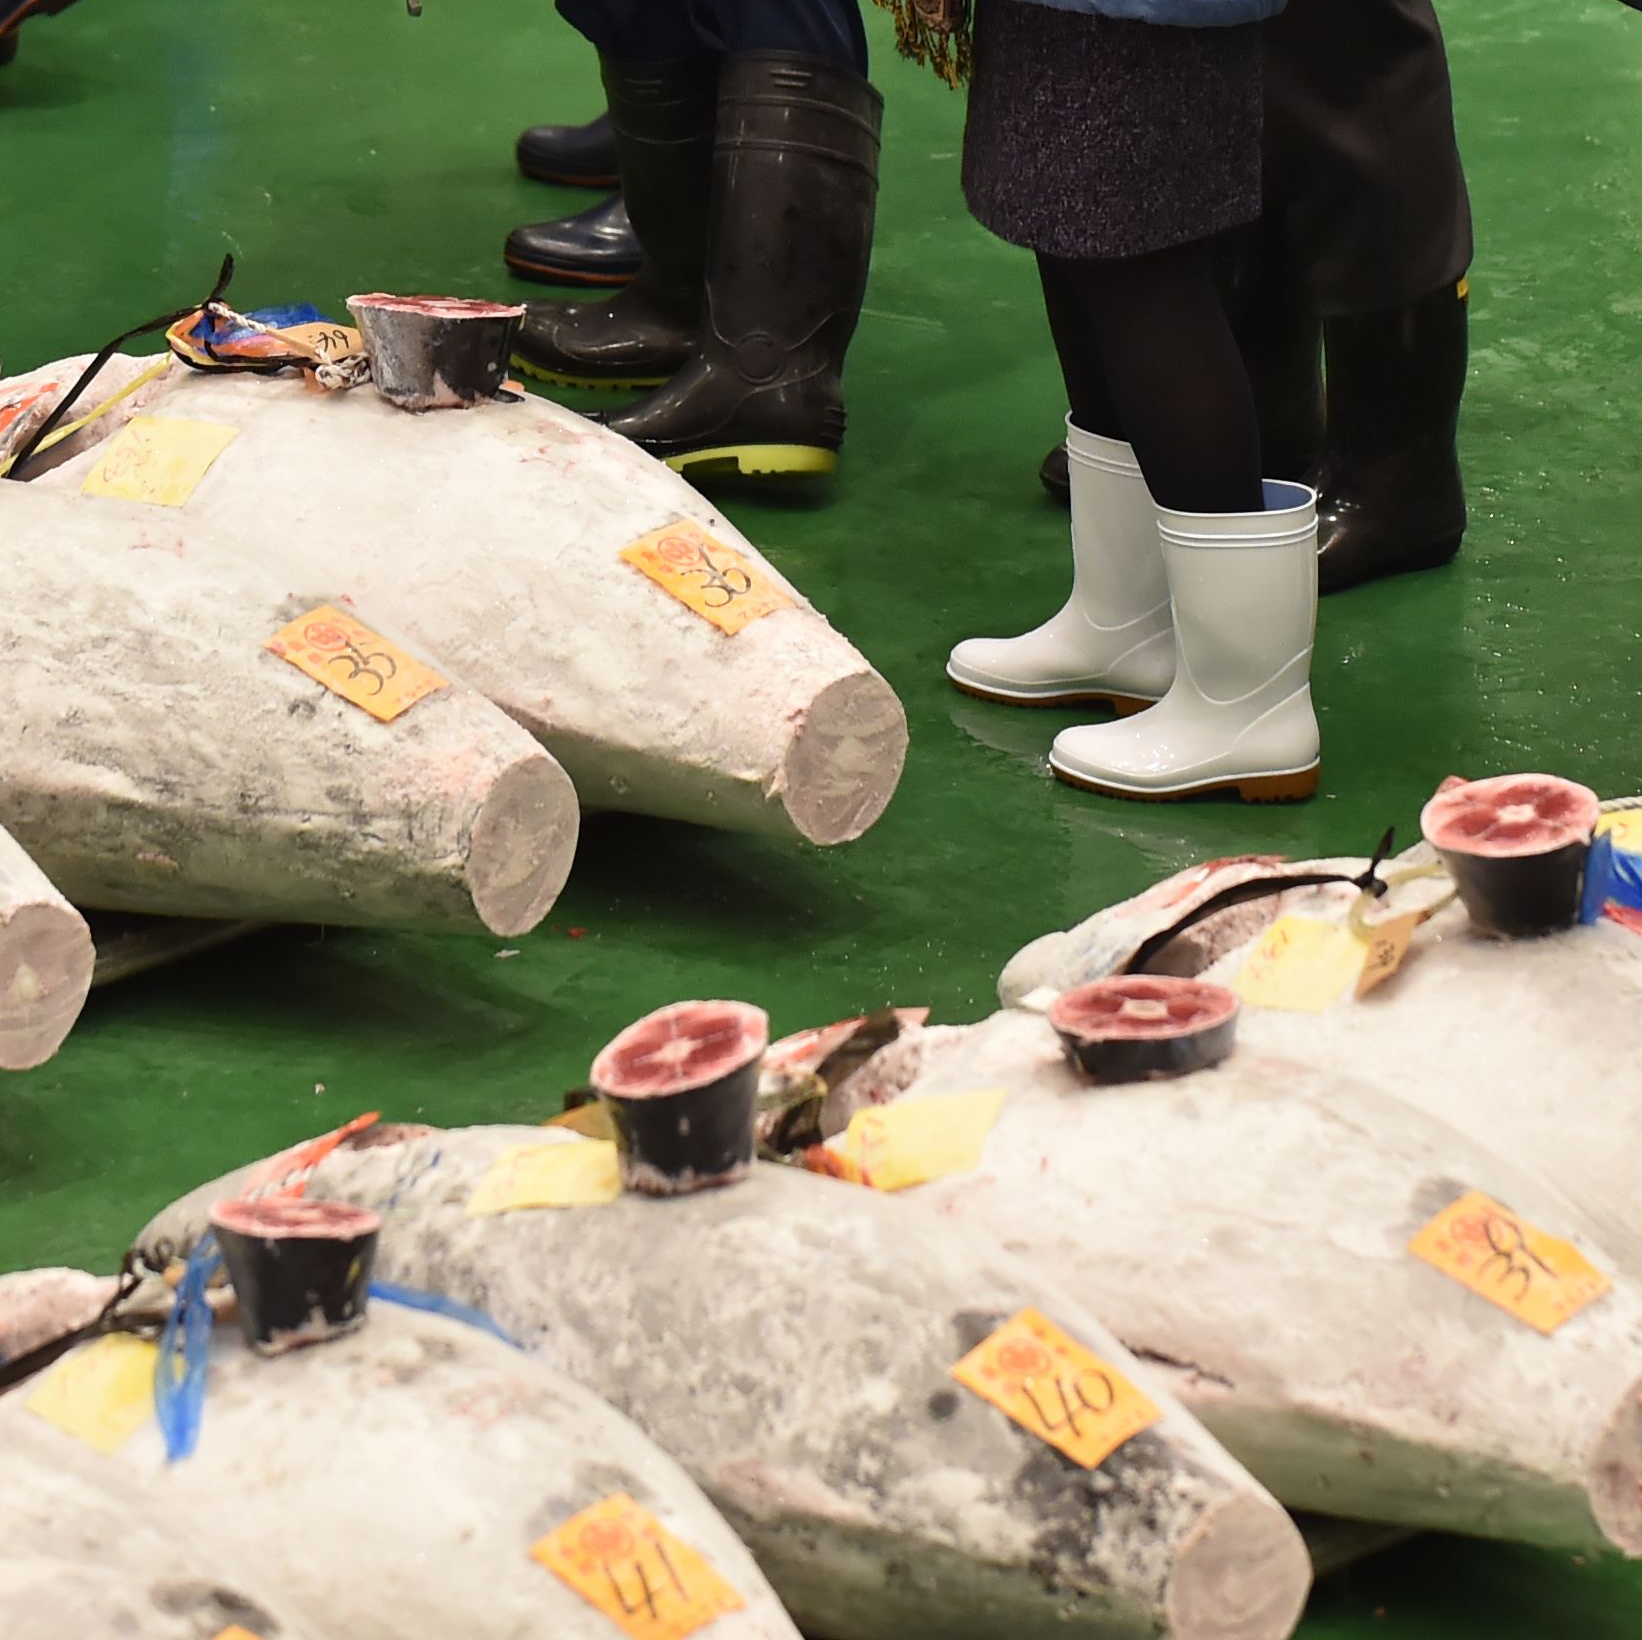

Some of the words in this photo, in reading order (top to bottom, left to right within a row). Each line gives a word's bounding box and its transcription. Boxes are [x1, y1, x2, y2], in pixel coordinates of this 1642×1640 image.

[680, 543, 752, 608] 36
[327, 640, 397, 696] 35
[1477, 1213, 1560, 1304] 39
[1020, 1369, 1114, 1438] 40
[603, 1542, 690, 1620] 41
